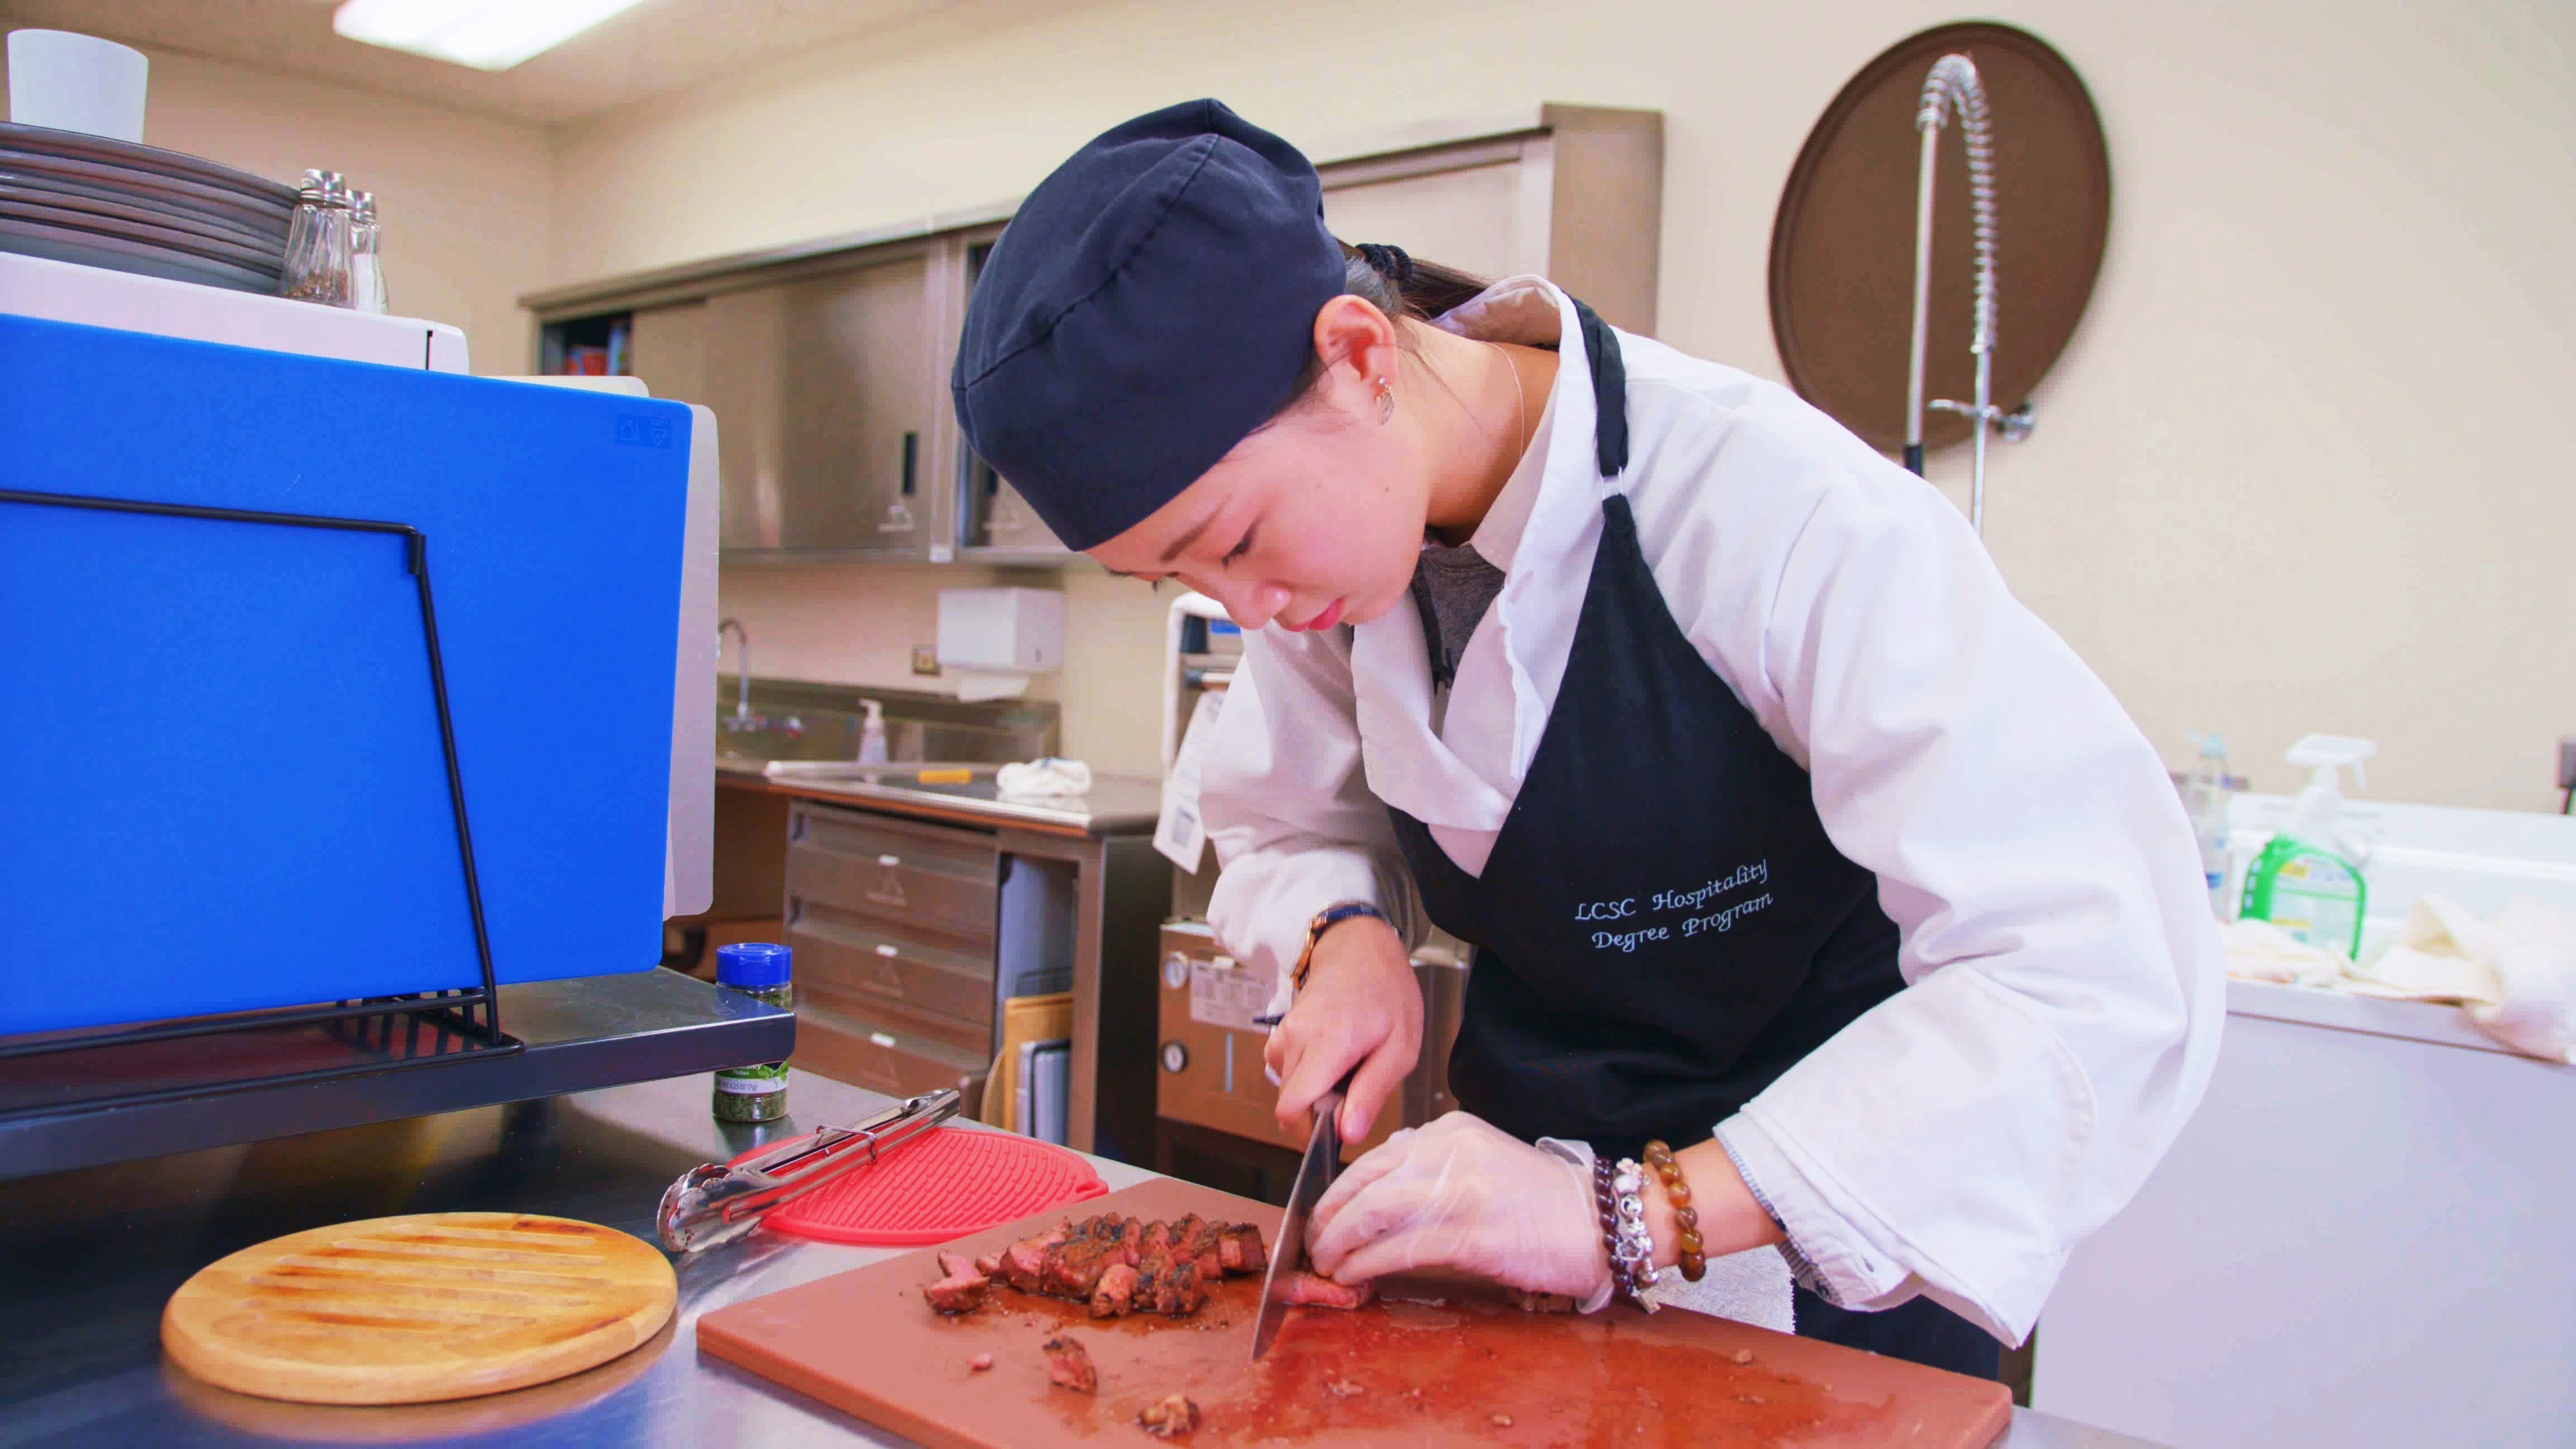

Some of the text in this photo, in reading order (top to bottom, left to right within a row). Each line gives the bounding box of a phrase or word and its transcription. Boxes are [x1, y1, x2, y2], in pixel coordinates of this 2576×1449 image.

[1575, 859, 1768, 920] LCSC Hospitality
[1592, 893, 1773, 952] Degree Program
